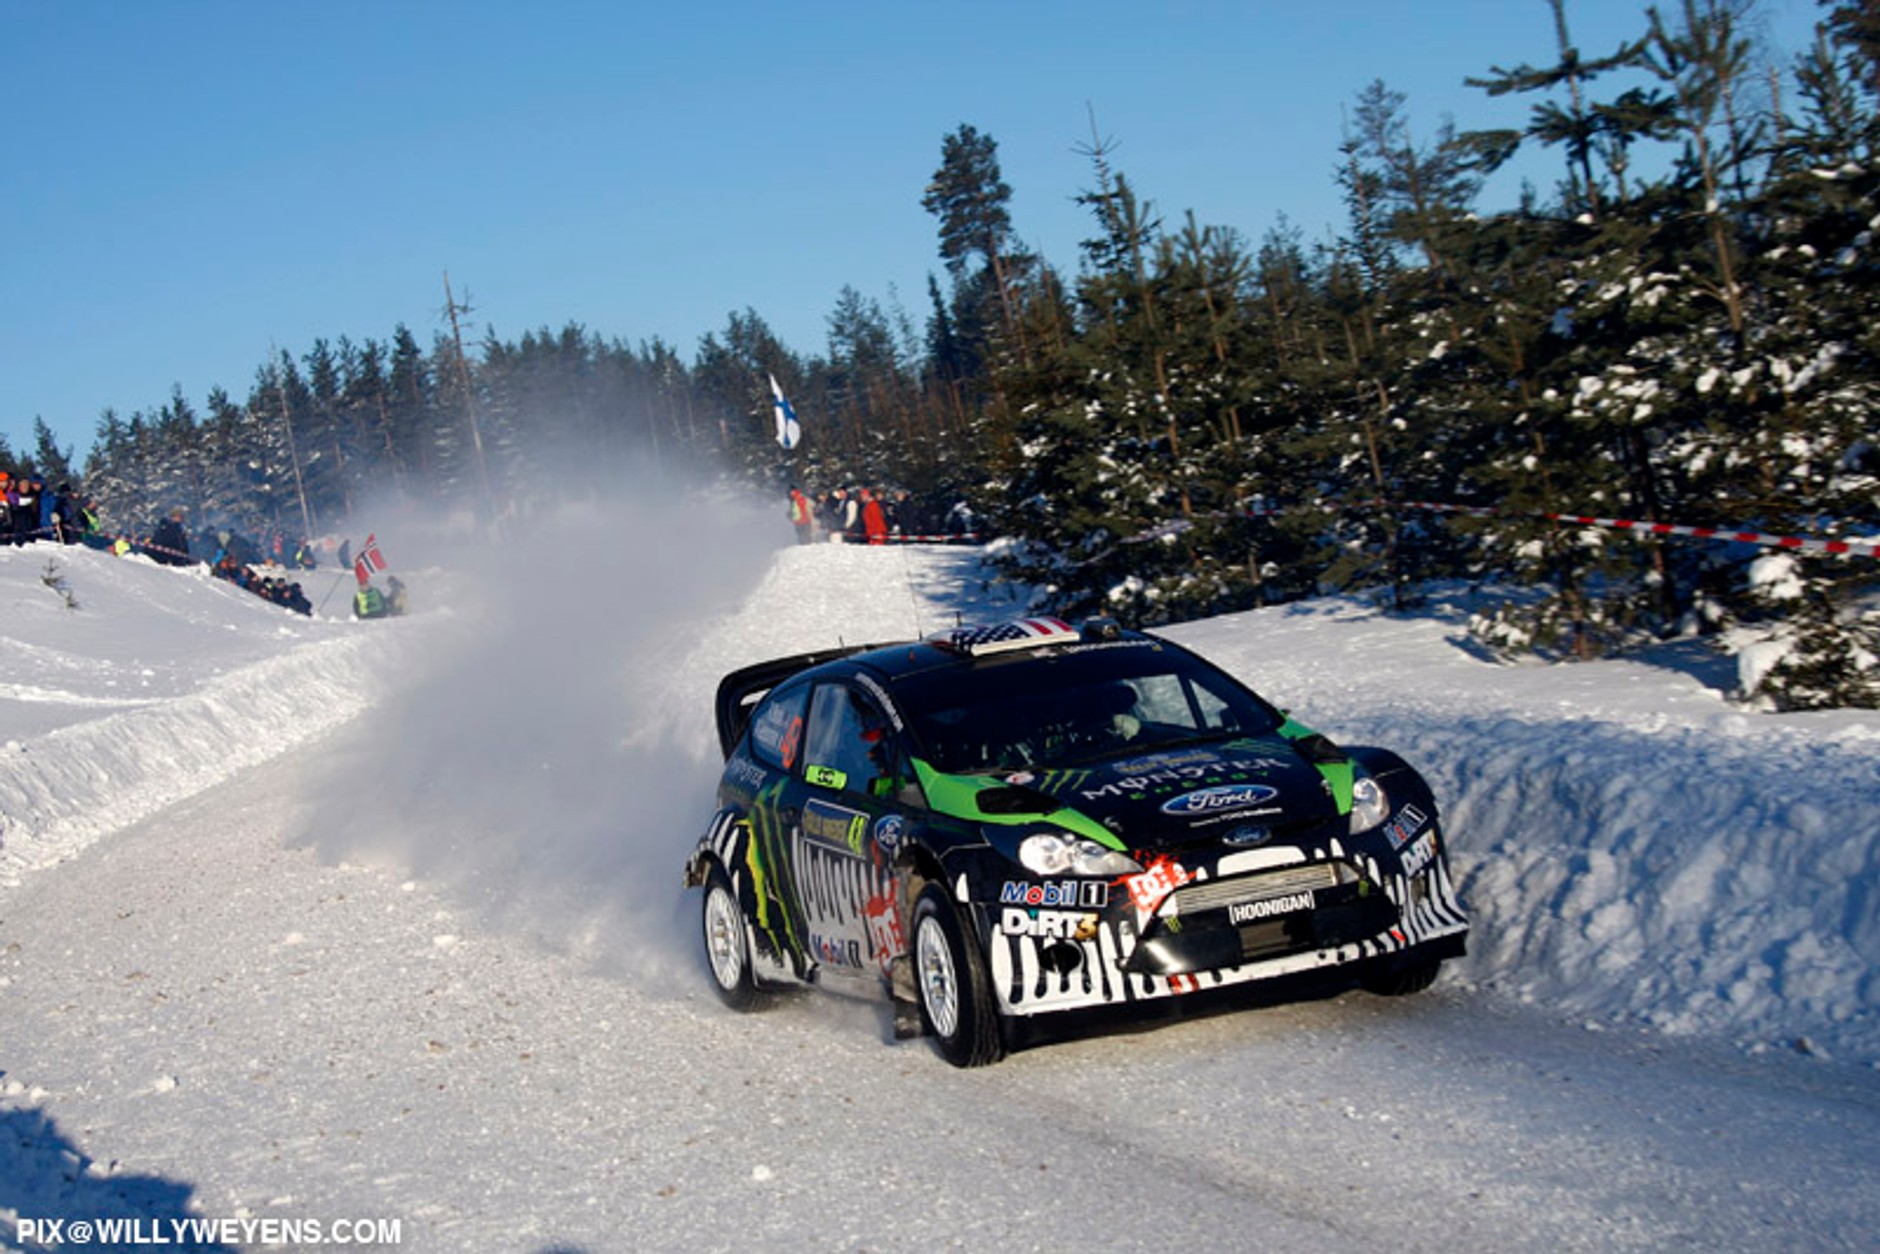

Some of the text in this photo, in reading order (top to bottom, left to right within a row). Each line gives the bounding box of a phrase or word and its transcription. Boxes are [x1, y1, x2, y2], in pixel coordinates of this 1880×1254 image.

[1081, 758, 1291, 800] MONSTER
[1186, 788, 1257, 811] Ford
[1001, 880, 1076, 906] Mobil
